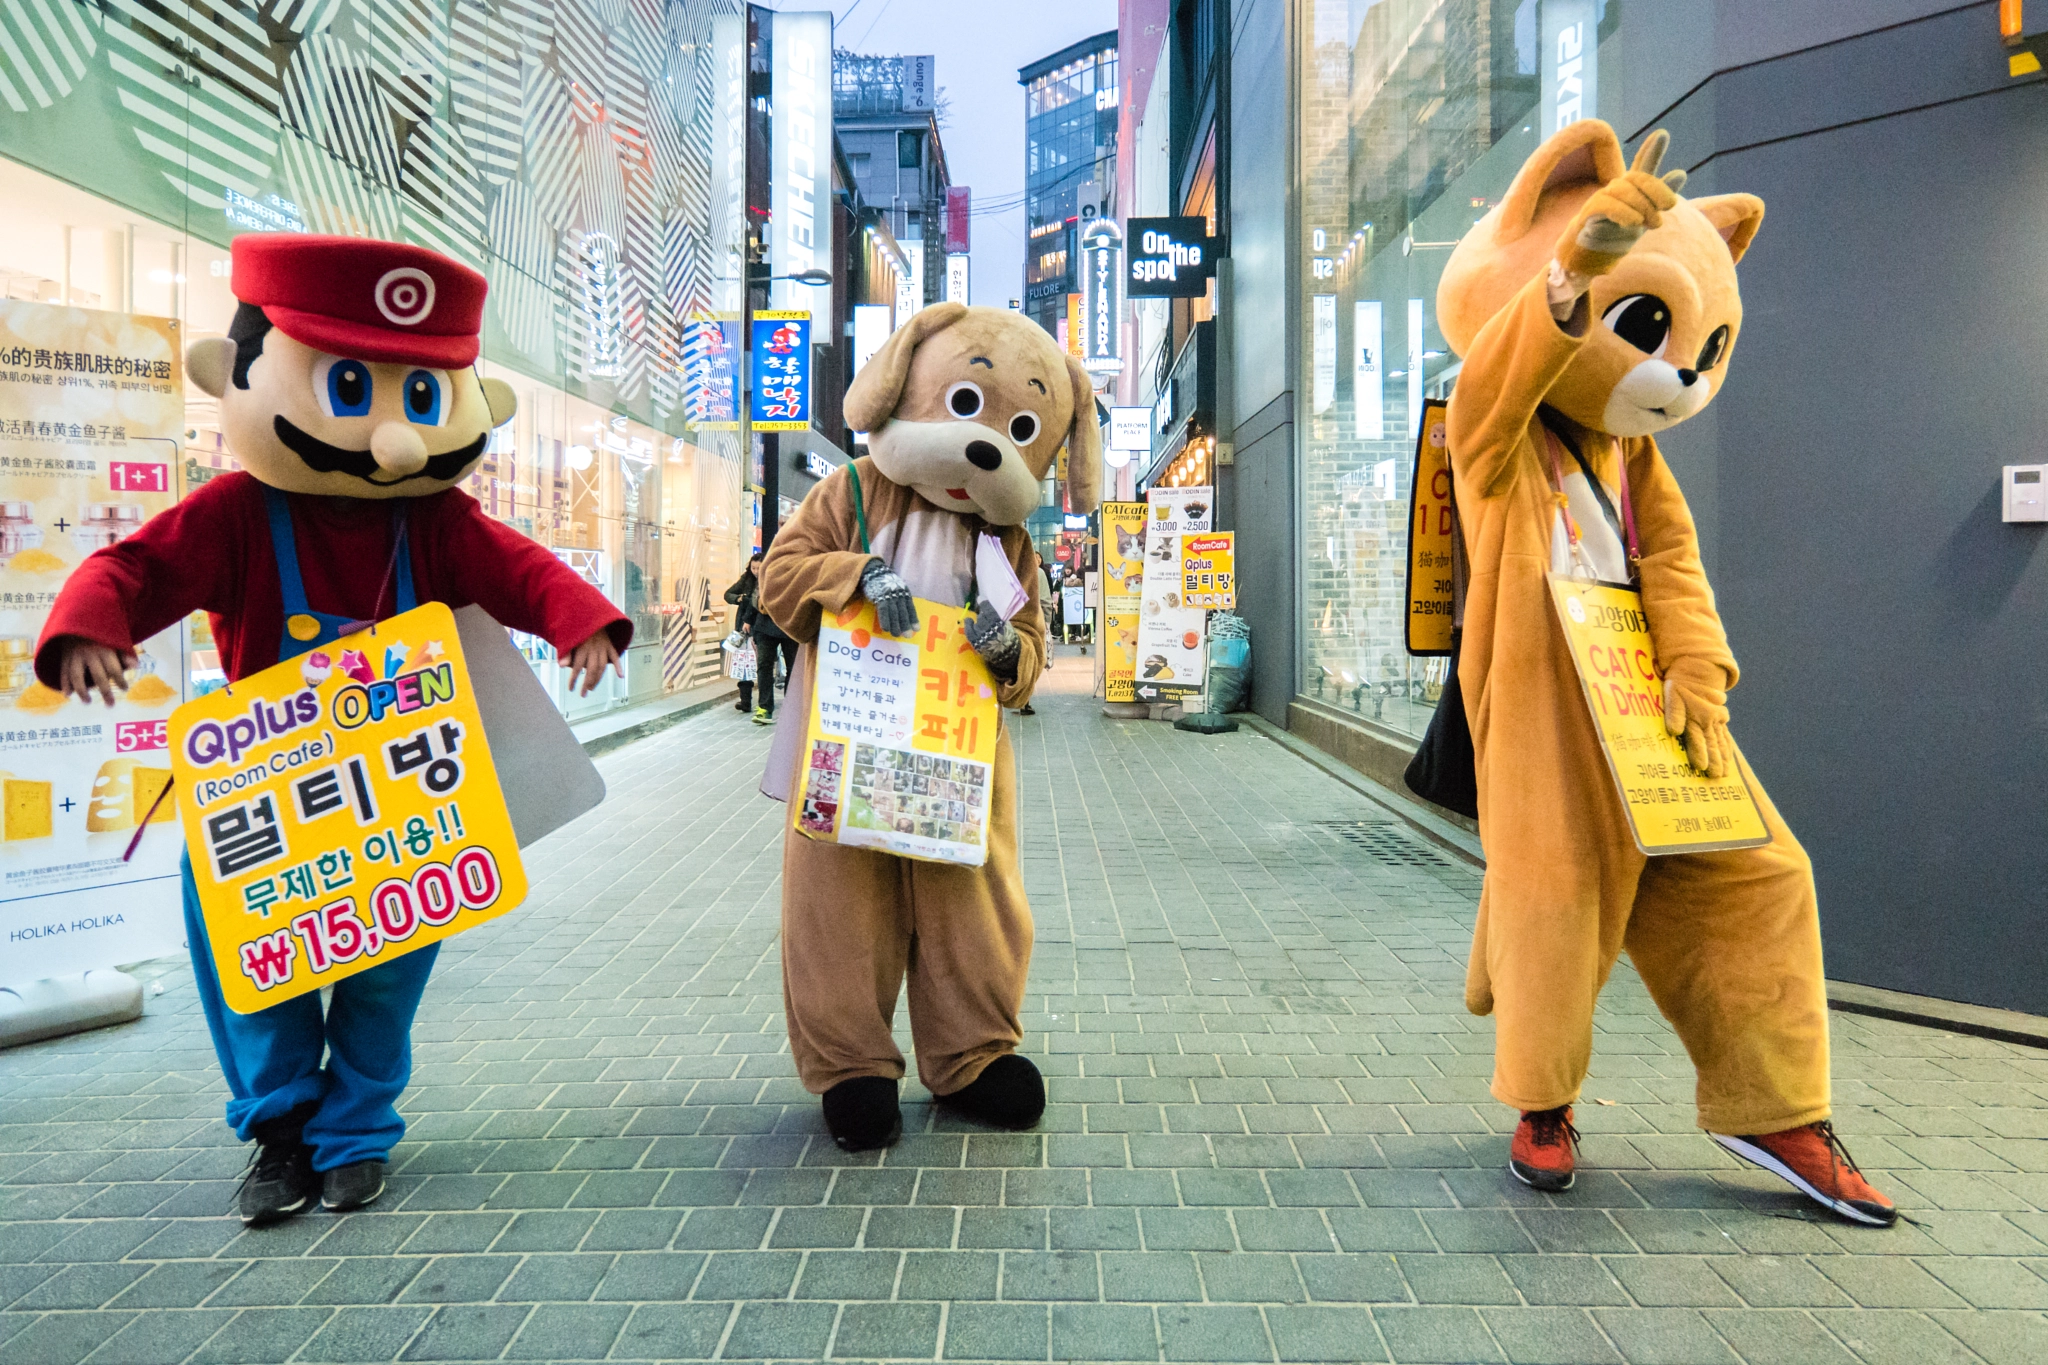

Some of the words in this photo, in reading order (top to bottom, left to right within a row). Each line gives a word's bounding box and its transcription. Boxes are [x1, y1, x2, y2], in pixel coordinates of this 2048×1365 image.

[913, 56, 927, 93] Lounge
[787, 36, 816, 310] SKECHERS
[1143, 231, 1170, 253] On
[1029, 283, 1060, 299] FULORE
[754, 422, 807, 430] Tel:757-3353
[114, 464, 164, 491] 1+1
[1185, 559, 1212, 572] Qplus
[828, 641, 861, 661] Dog
[872, 650, 911, 667] Cafe
[1589, 644, 1634, 679] CAT
[833, 668, 862, 682] 귀여운
[838, 686, 896, 704] 강아지들과
[1609, 683, 1665, 717] Drink
[188, 692, 319, 764] Qplus
[333, 662, 455, 729] OPEN
[821, 702, 862, 717] 함께하는
[868, 710, 898, 724] 즐거운
[195, 760, 267, 806] (Room
[271, 732, 334, 774] Cafe)
[1637, 764, 1671, 779] 귀여운
[1627, 787, 1679, 804] 고양이들과
[1682, 786, 1711, 803] 즐거운
[1672, 817, 1701, 833] 고양이
[244, 850, 353, 916] 무제한
[365, 804, 465, 864] 이용!!
[10, 923, 67, 942] HOLIKA
[71, 913, 125, 932] HOLIKA
[243, 848, 500, 990] ₩15,000
